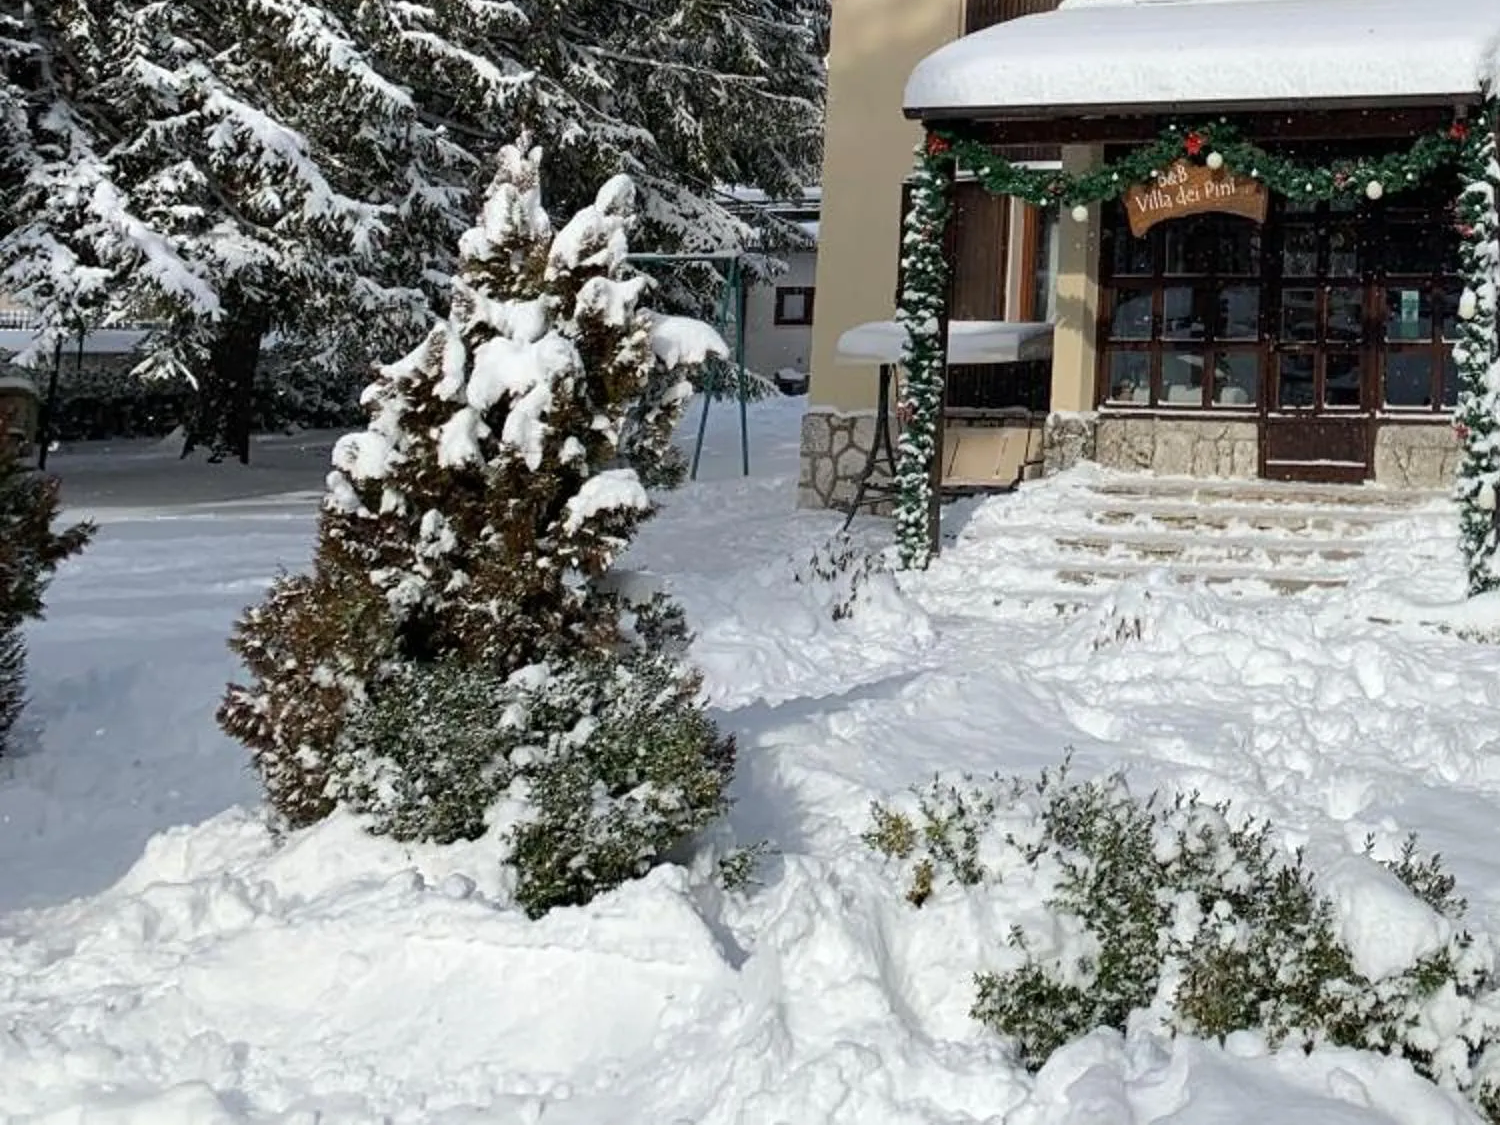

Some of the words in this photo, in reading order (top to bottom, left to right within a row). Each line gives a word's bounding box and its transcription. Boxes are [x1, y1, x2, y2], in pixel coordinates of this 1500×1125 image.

[1135, 189, 1173, 213] Villa
[1175, 184, 1200, 205] dei
[1204, 177, 1237, 198] Pini
